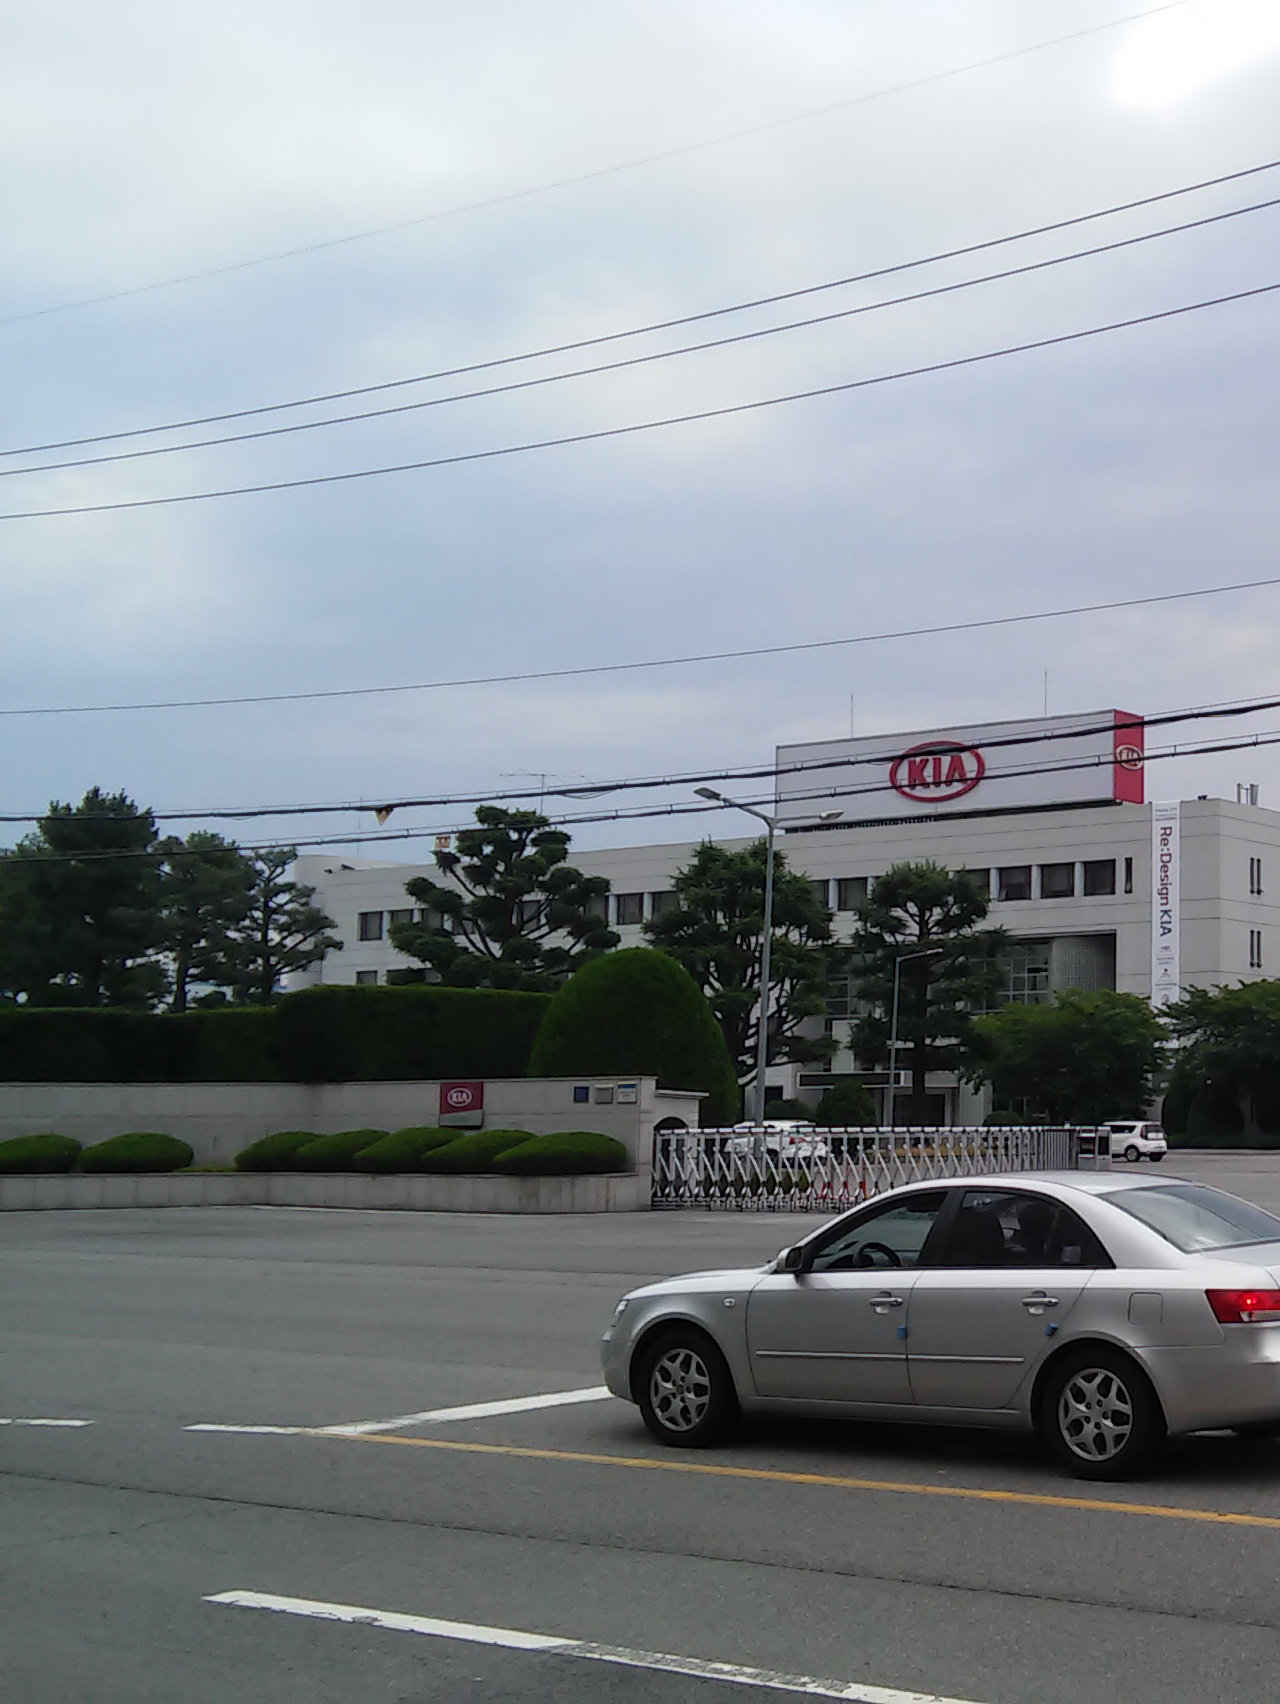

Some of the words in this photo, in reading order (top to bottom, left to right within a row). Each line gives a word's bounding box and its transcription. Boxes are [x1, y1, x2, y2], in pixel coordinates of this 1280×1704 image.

[908, 755, 968, 790] KIA
[1157, 826, 1173, 906] Re:Design
[1159, 909, 1173, 937] KIA
[452, 1092, 468, 1103] KIA
